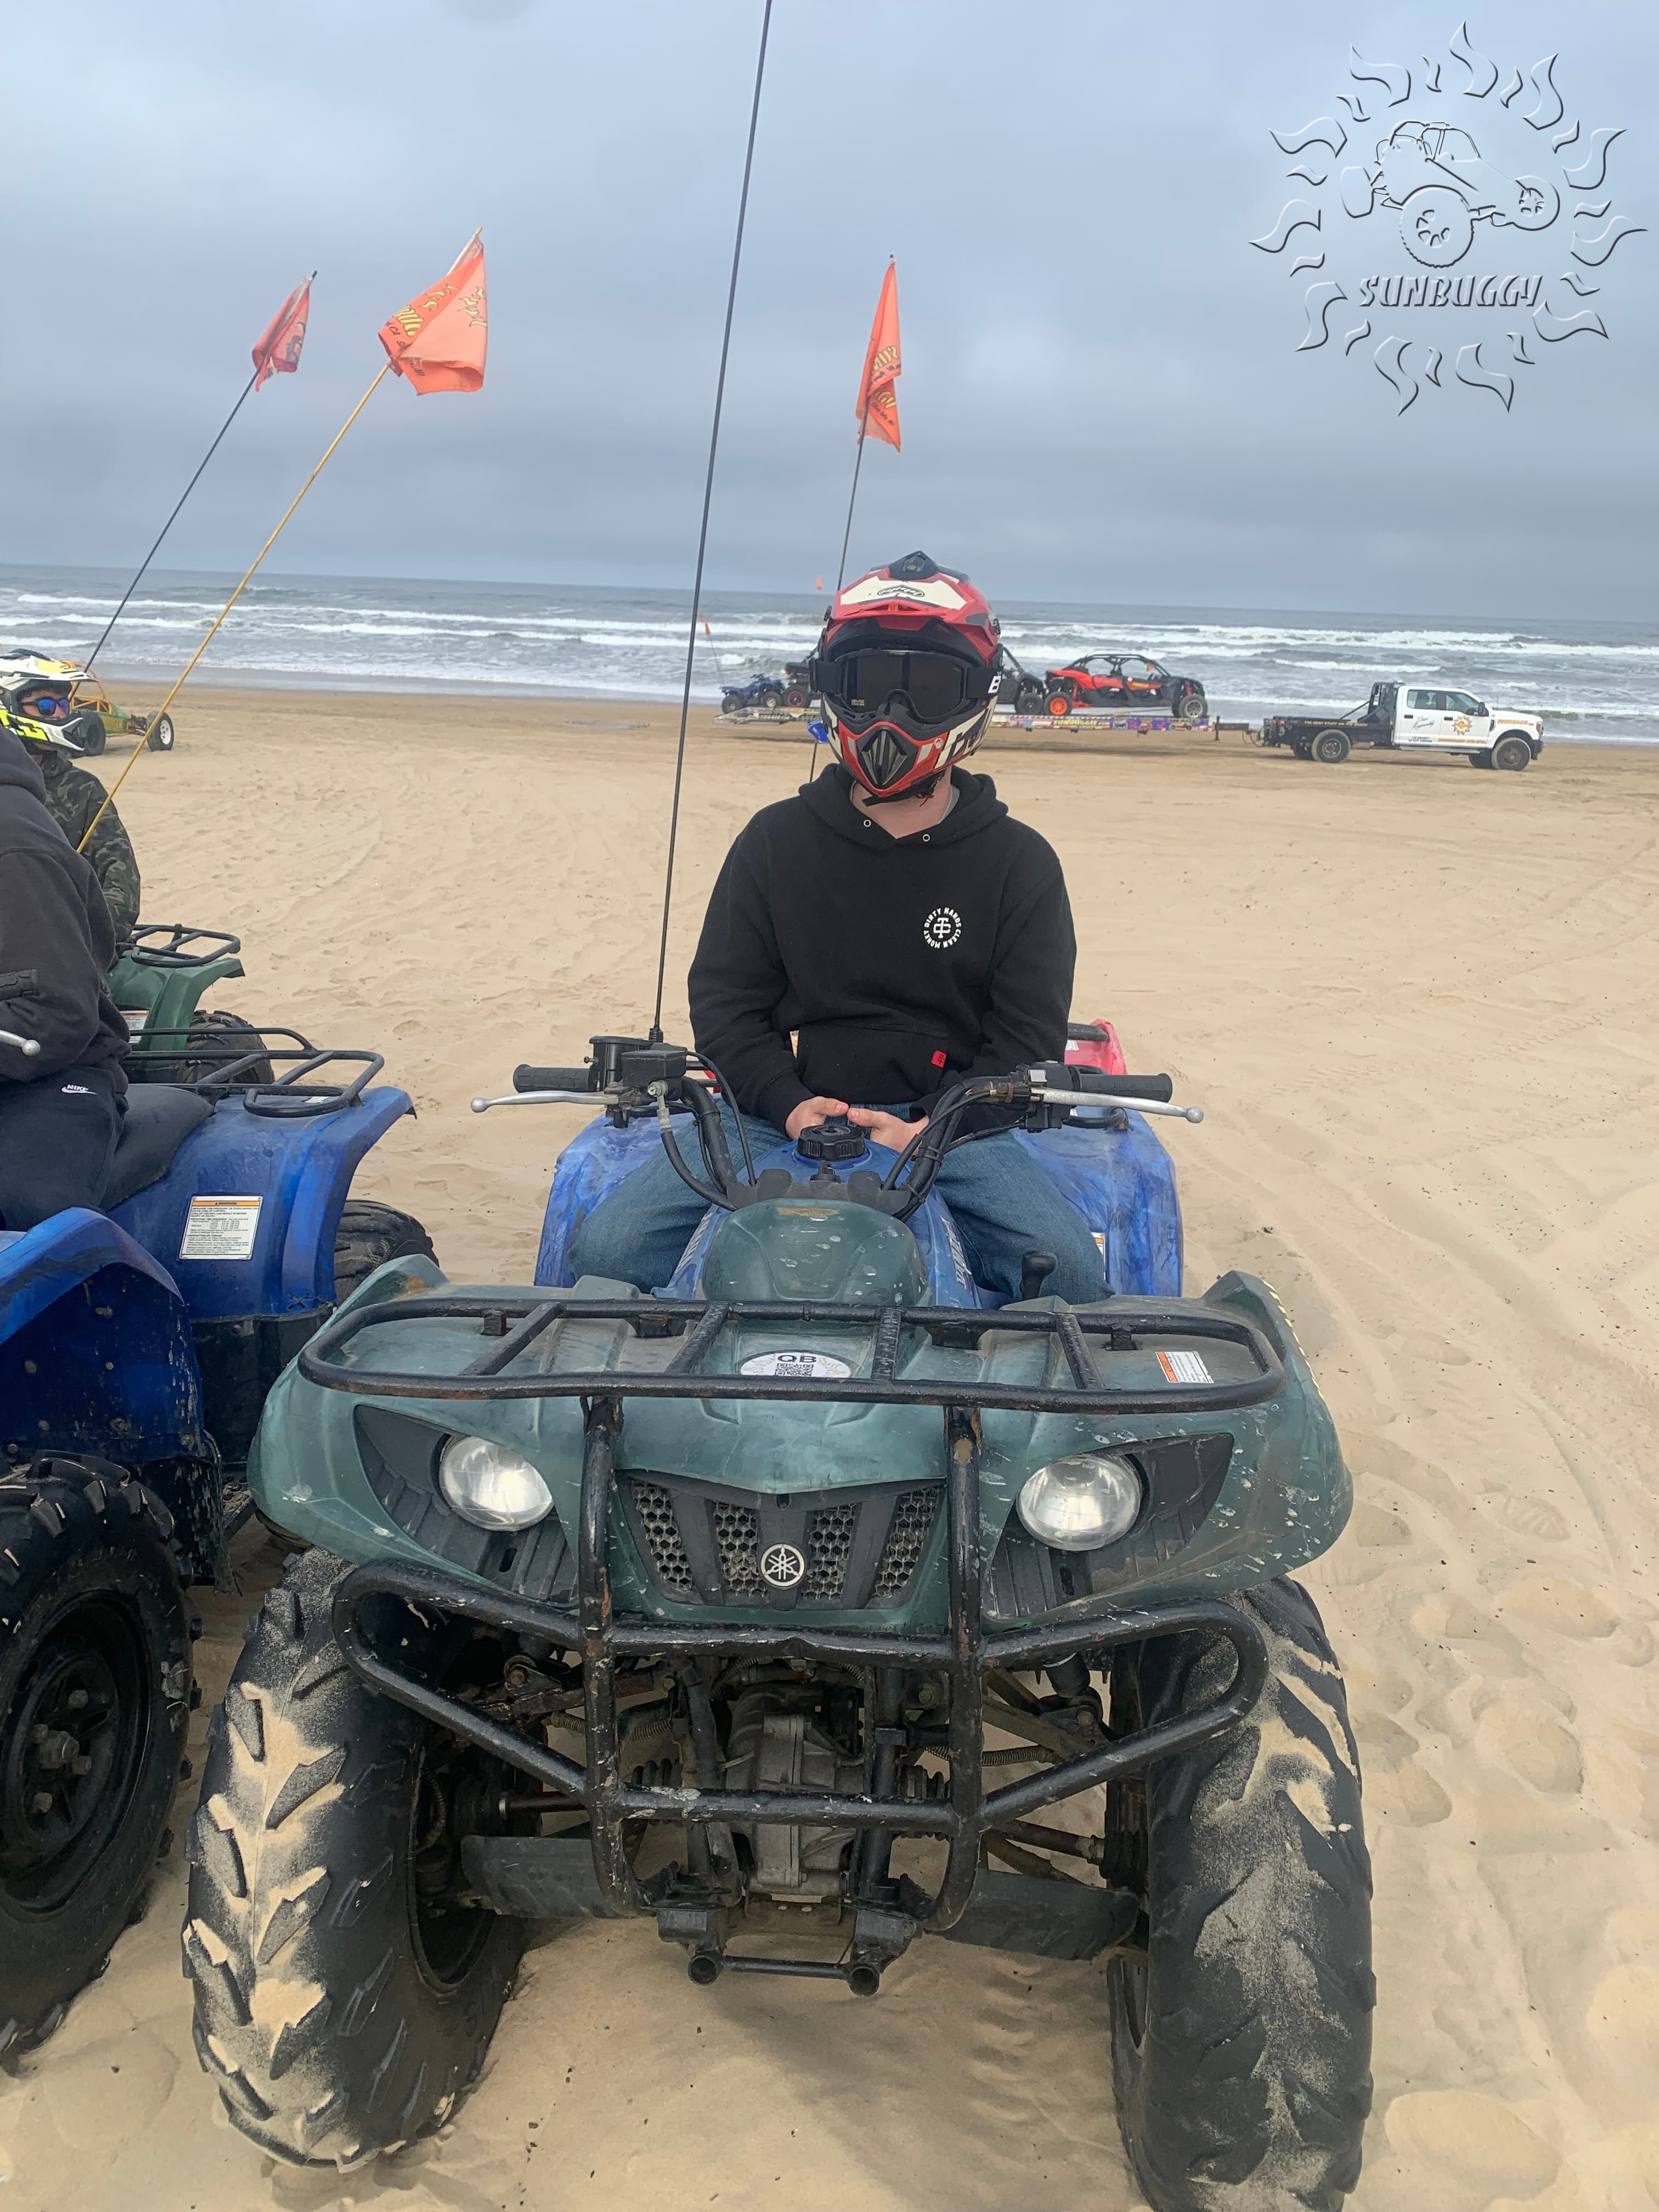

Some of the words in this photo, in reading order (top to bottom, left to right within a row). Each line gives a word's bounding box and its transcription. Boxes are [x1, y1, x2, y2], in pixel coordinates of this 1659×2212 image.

[924, 908, 941, 928] DIRTY
[944, 907, 962, 927] HANDS
[923, 930, 941, 949] MONEY
[943, 929, 961, 948] CLEAN
[778, 1355, 816, 1363] QB
